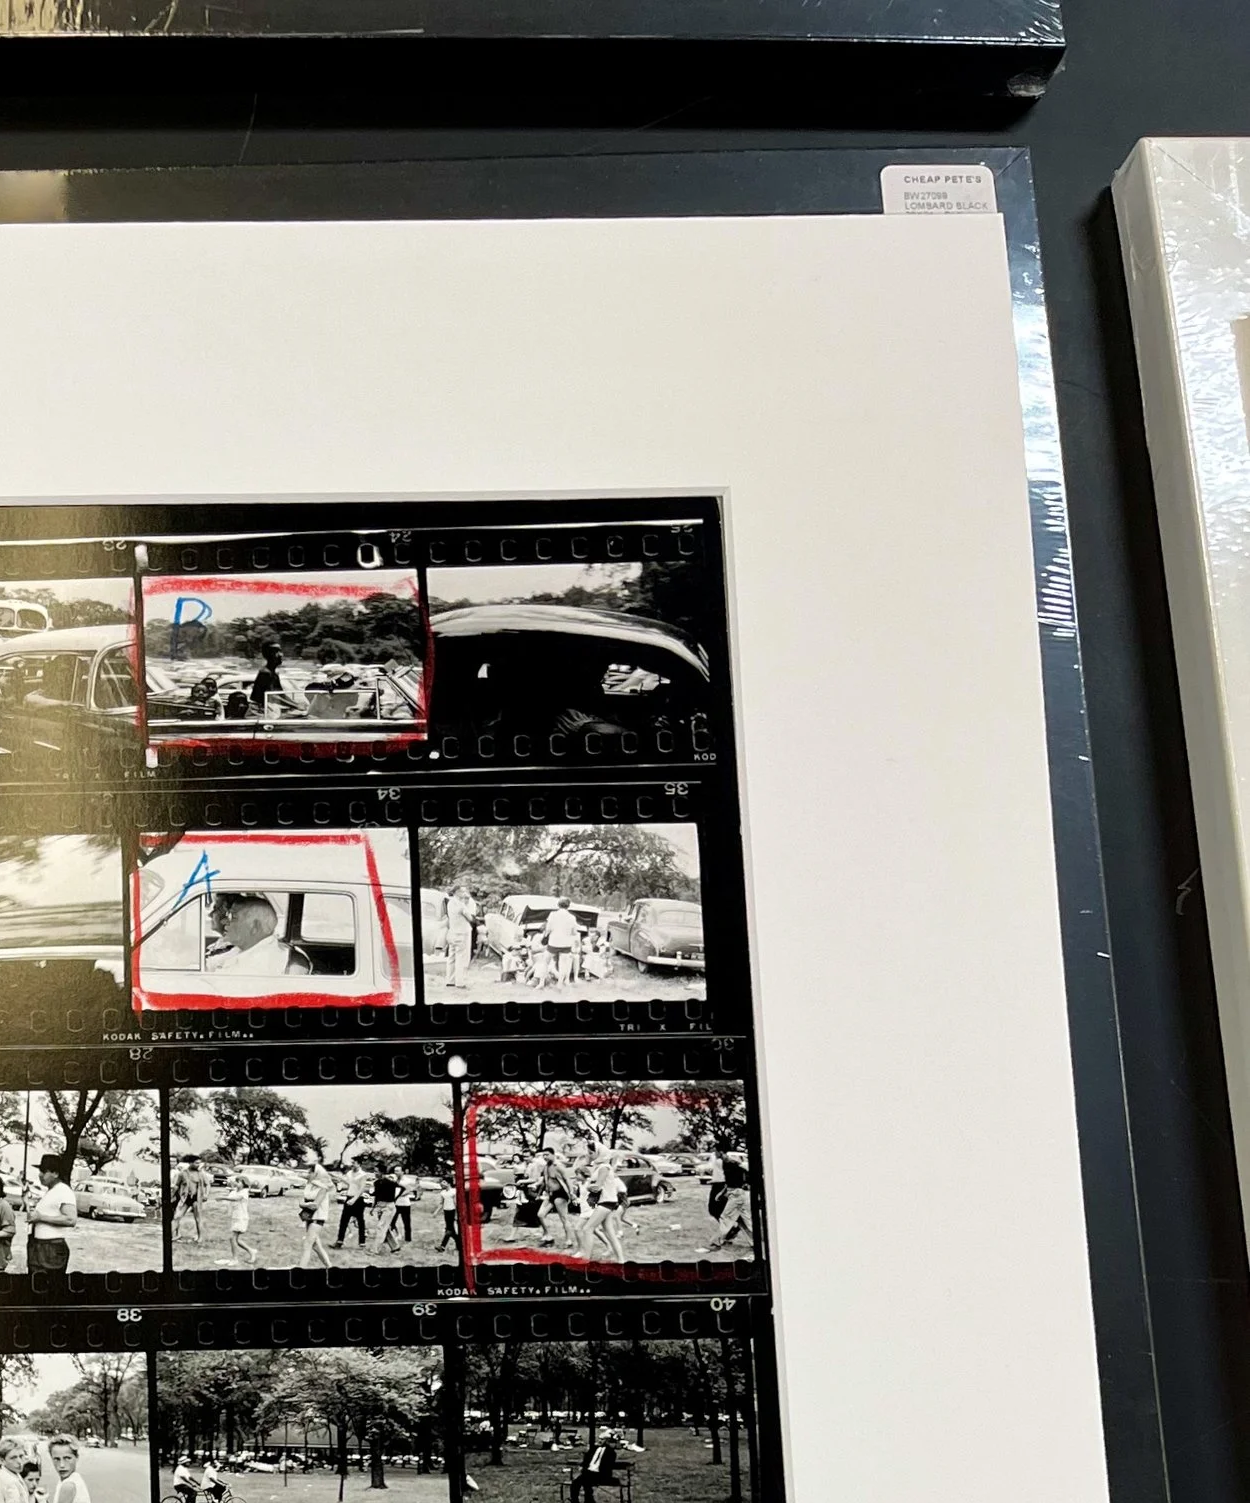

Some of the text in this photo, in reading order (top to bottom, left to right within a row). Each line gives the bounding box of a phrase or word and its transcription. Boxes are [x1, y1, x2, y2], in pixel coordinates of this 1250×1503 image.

[903, 175, 982, 184] CHEAP PETE'S
[904, 201, 989, 210] LOMBARD BLACK
[124, 770, 157, 779] FILM
[377, 787, 400, 800] 34
[665, 782, 689, 795] 35
[171, 848, 221, 912] A
[103, 1032, 142, 1041] KODAK
[129, 1047, 153, 1061] 28
[437, 1287, 477, 1296] KODAK
[412, 1303, 437, 1316] 39
[710, 1297, 737, 1311] 40
[116, 1308, 142, 1322] 38
